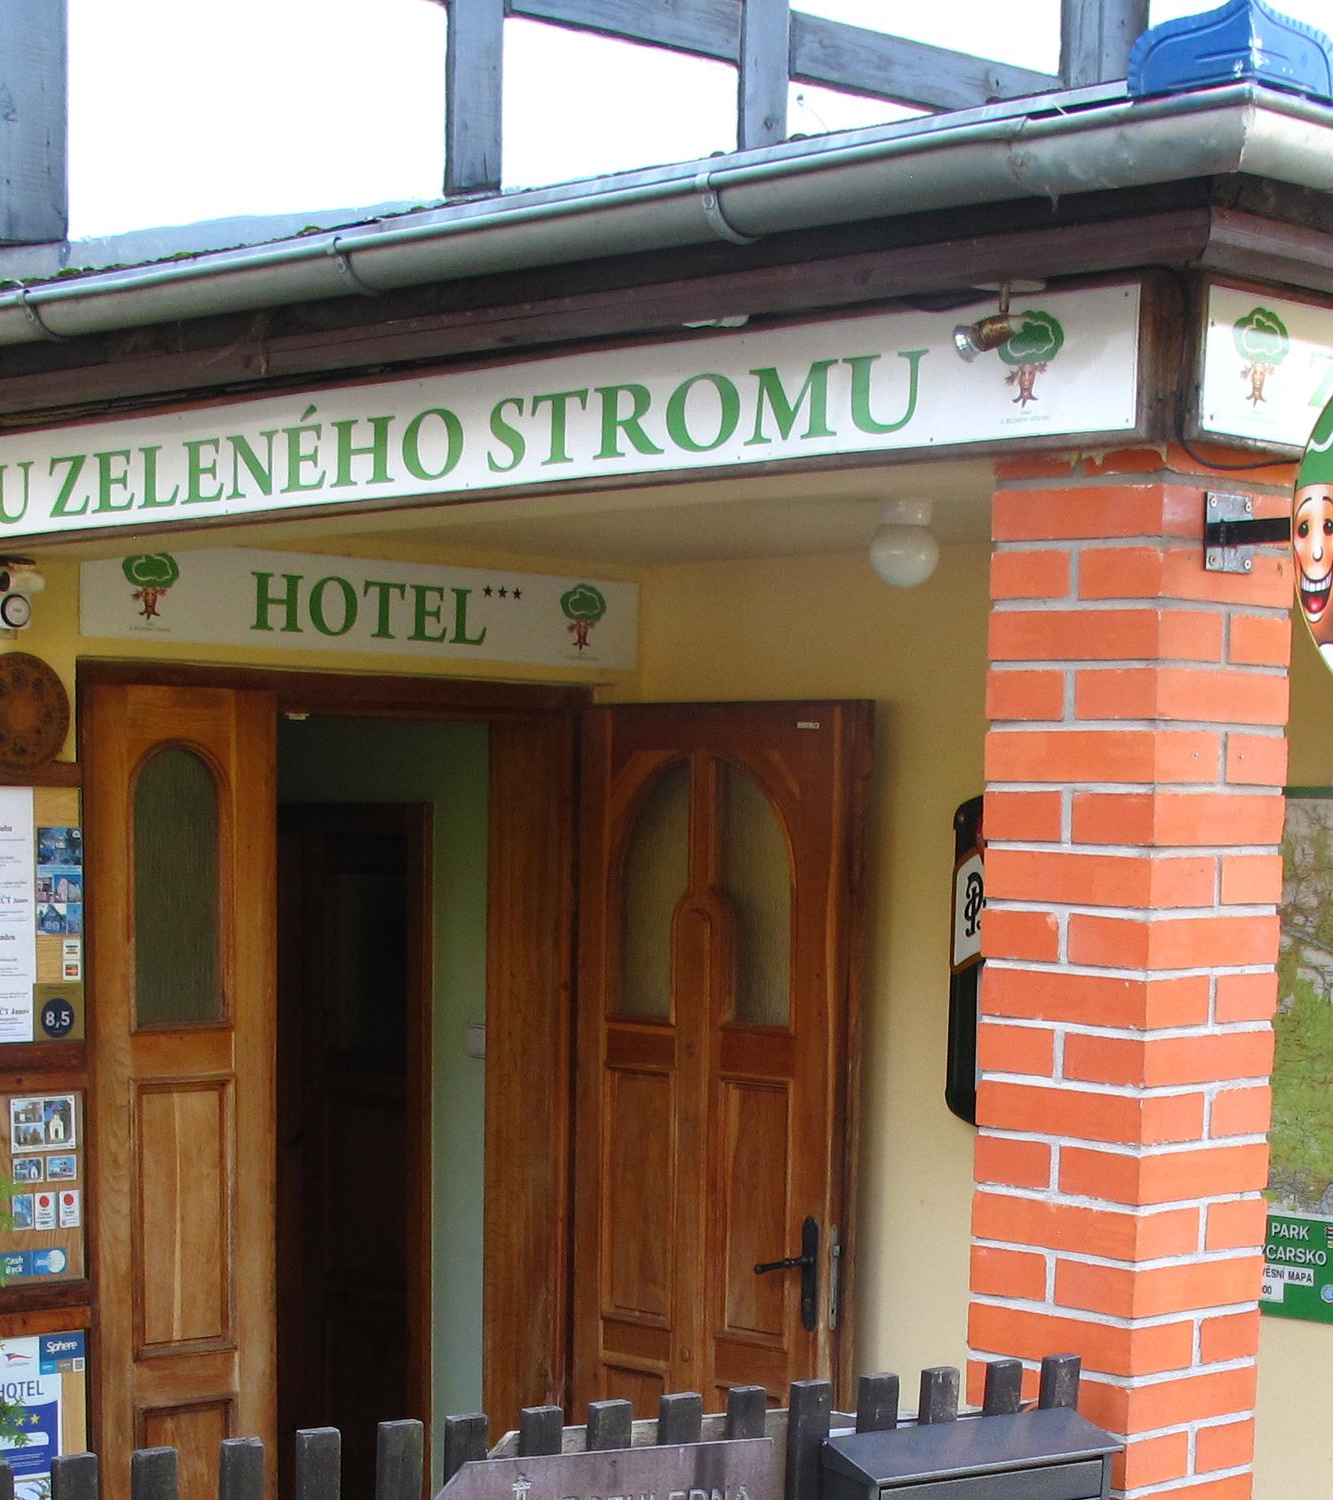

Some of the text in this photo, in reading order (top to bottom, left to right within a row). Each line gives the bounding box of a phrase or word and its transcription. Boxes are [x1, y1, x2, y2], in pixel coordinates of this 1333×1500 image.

[50, 404, 464, 518] ZELENÉHO
[486, 349, 929, 473] STROMU
[251, 571, 488, 646] HOTEL
[45, 1011, 71, 1028] 8,5
[1270, 1222, 1310, 1241] PARK
[1287, 1270, 1313, 1283] MAPA
[46, 1341, 78, 1354] Sphere
